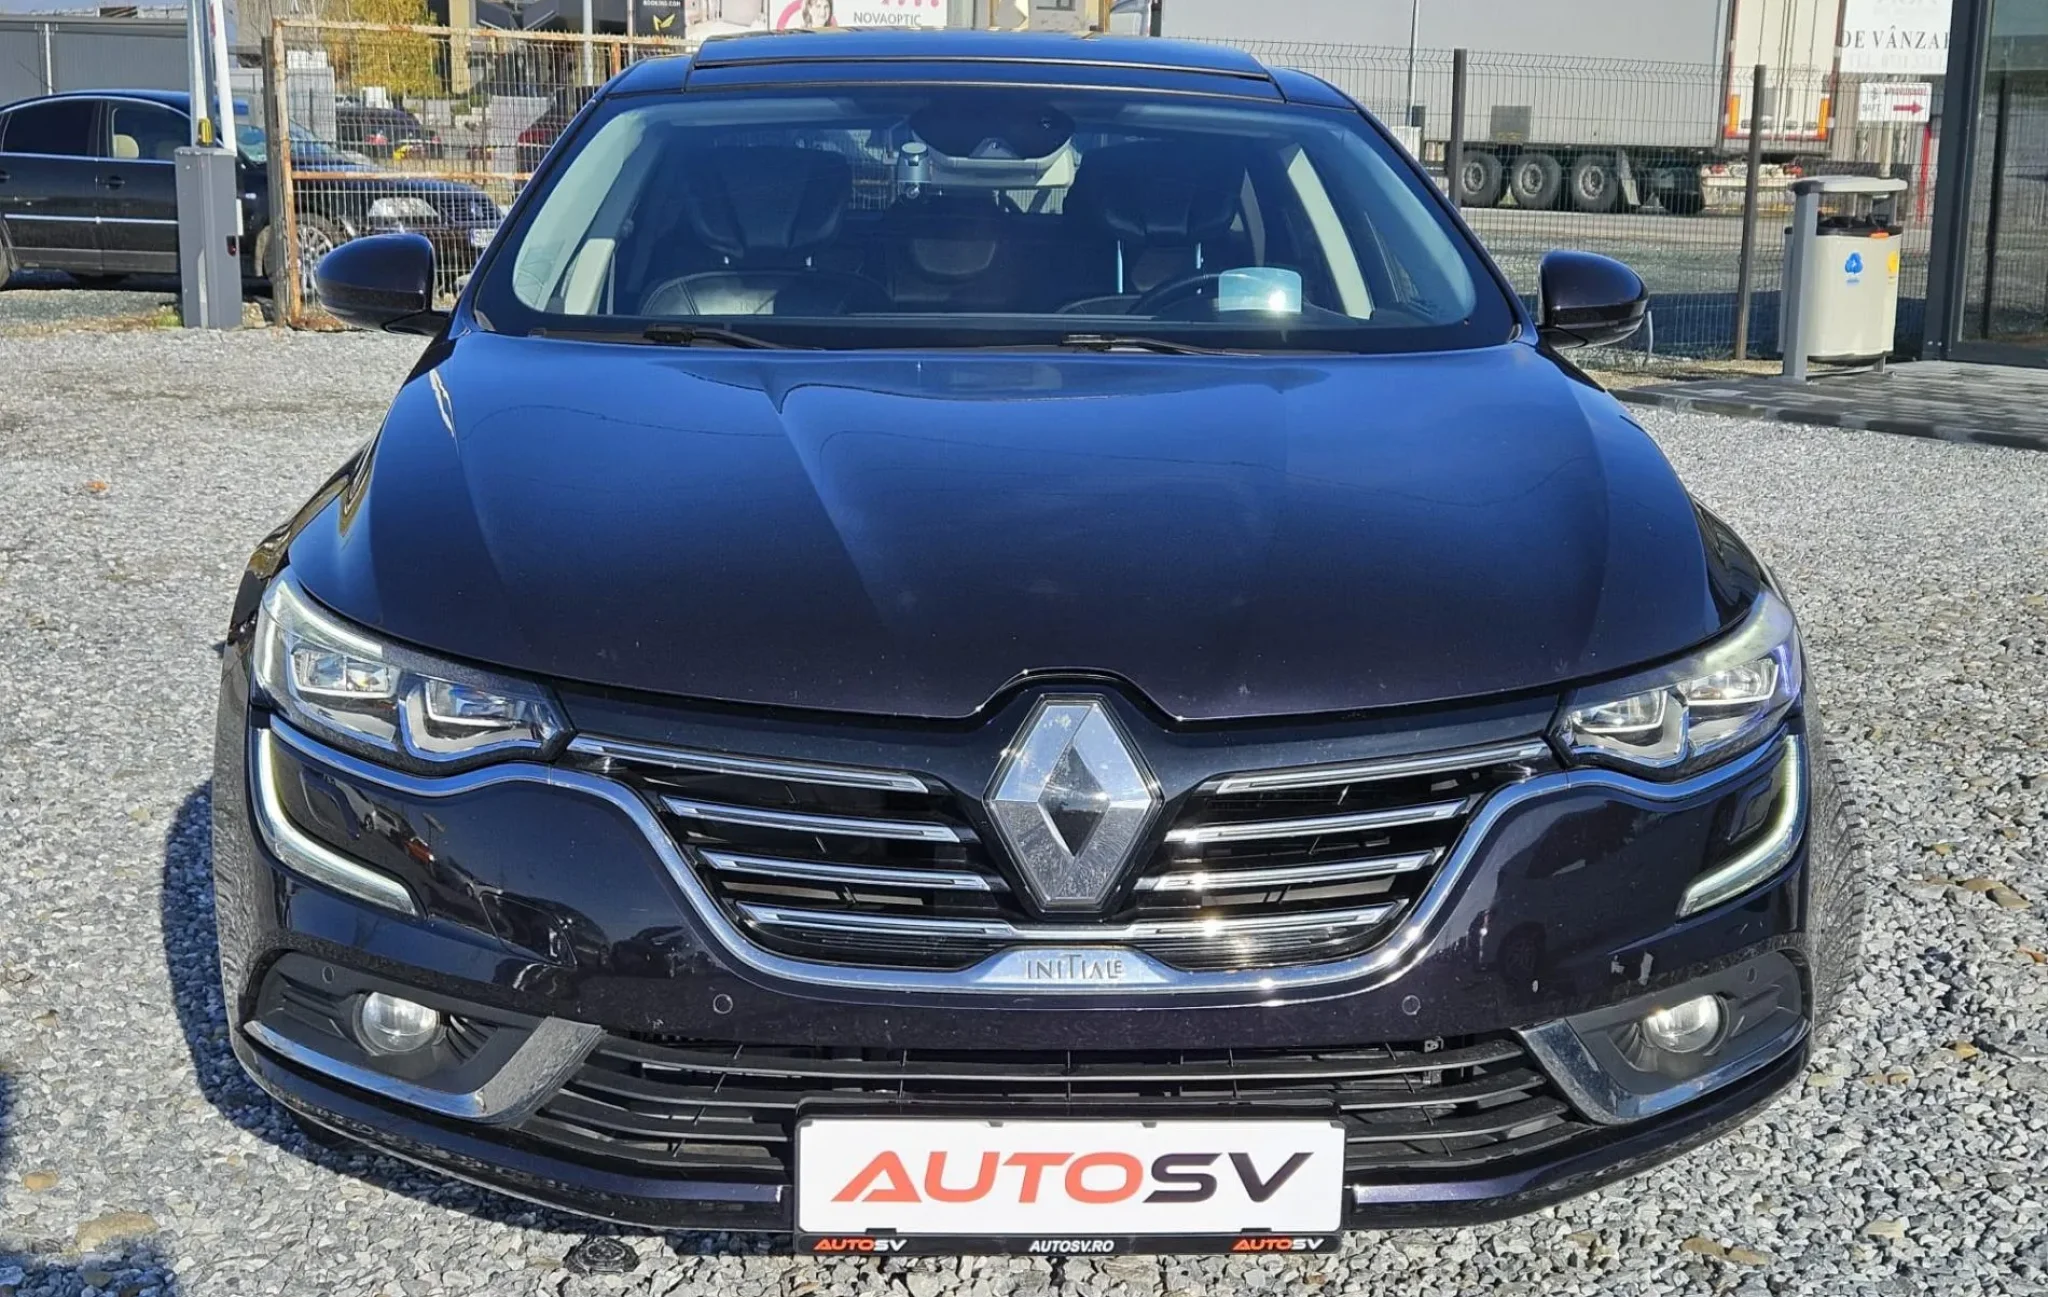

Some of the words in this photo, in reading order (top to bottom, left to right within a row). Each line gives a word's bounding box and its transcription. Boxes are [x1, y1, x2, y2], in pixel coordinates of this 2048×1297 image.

[853, 12, 922, 26] NOVAOPTIC
[1026, 954, 1123, 979] INITIALE
[830, 1150, 1315, 1204] AUTOSV
[813, 1238, 908, 1252] AUTOSV
[1028, 1239, 1115, 1254] AUTOSV.RO
[1229, 1237, 1324, 1251] AUTOSV
